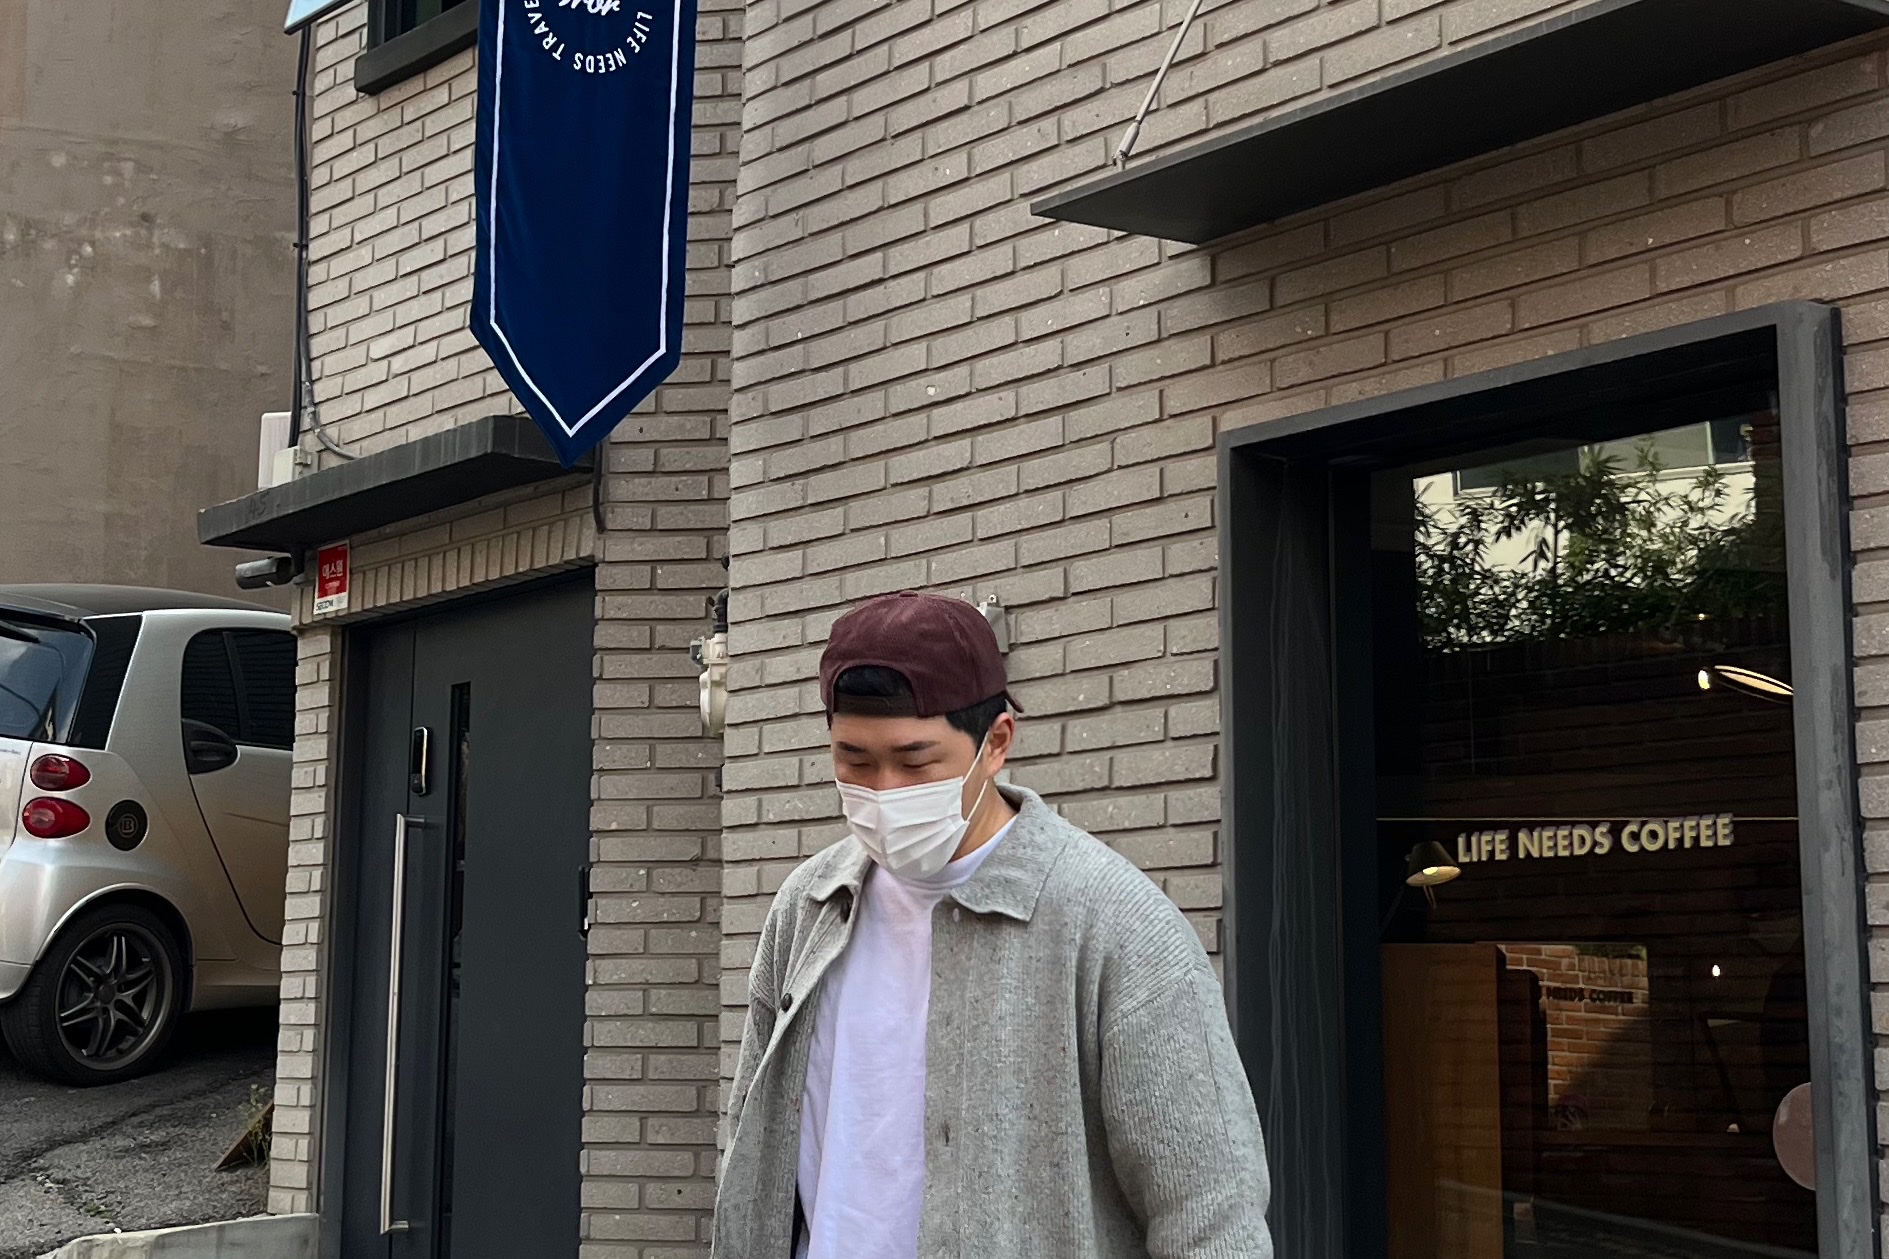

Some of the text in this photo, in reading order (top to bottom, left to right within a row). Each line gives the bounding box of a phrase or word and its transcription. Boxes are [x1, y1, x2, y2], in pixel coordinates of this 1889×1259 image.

[626, 12, 652, 53] LIFE
[573, 48, 627, 73] NEEDS
[1457, 813, 1734, 862] LIFE NEEDS COFFEE
